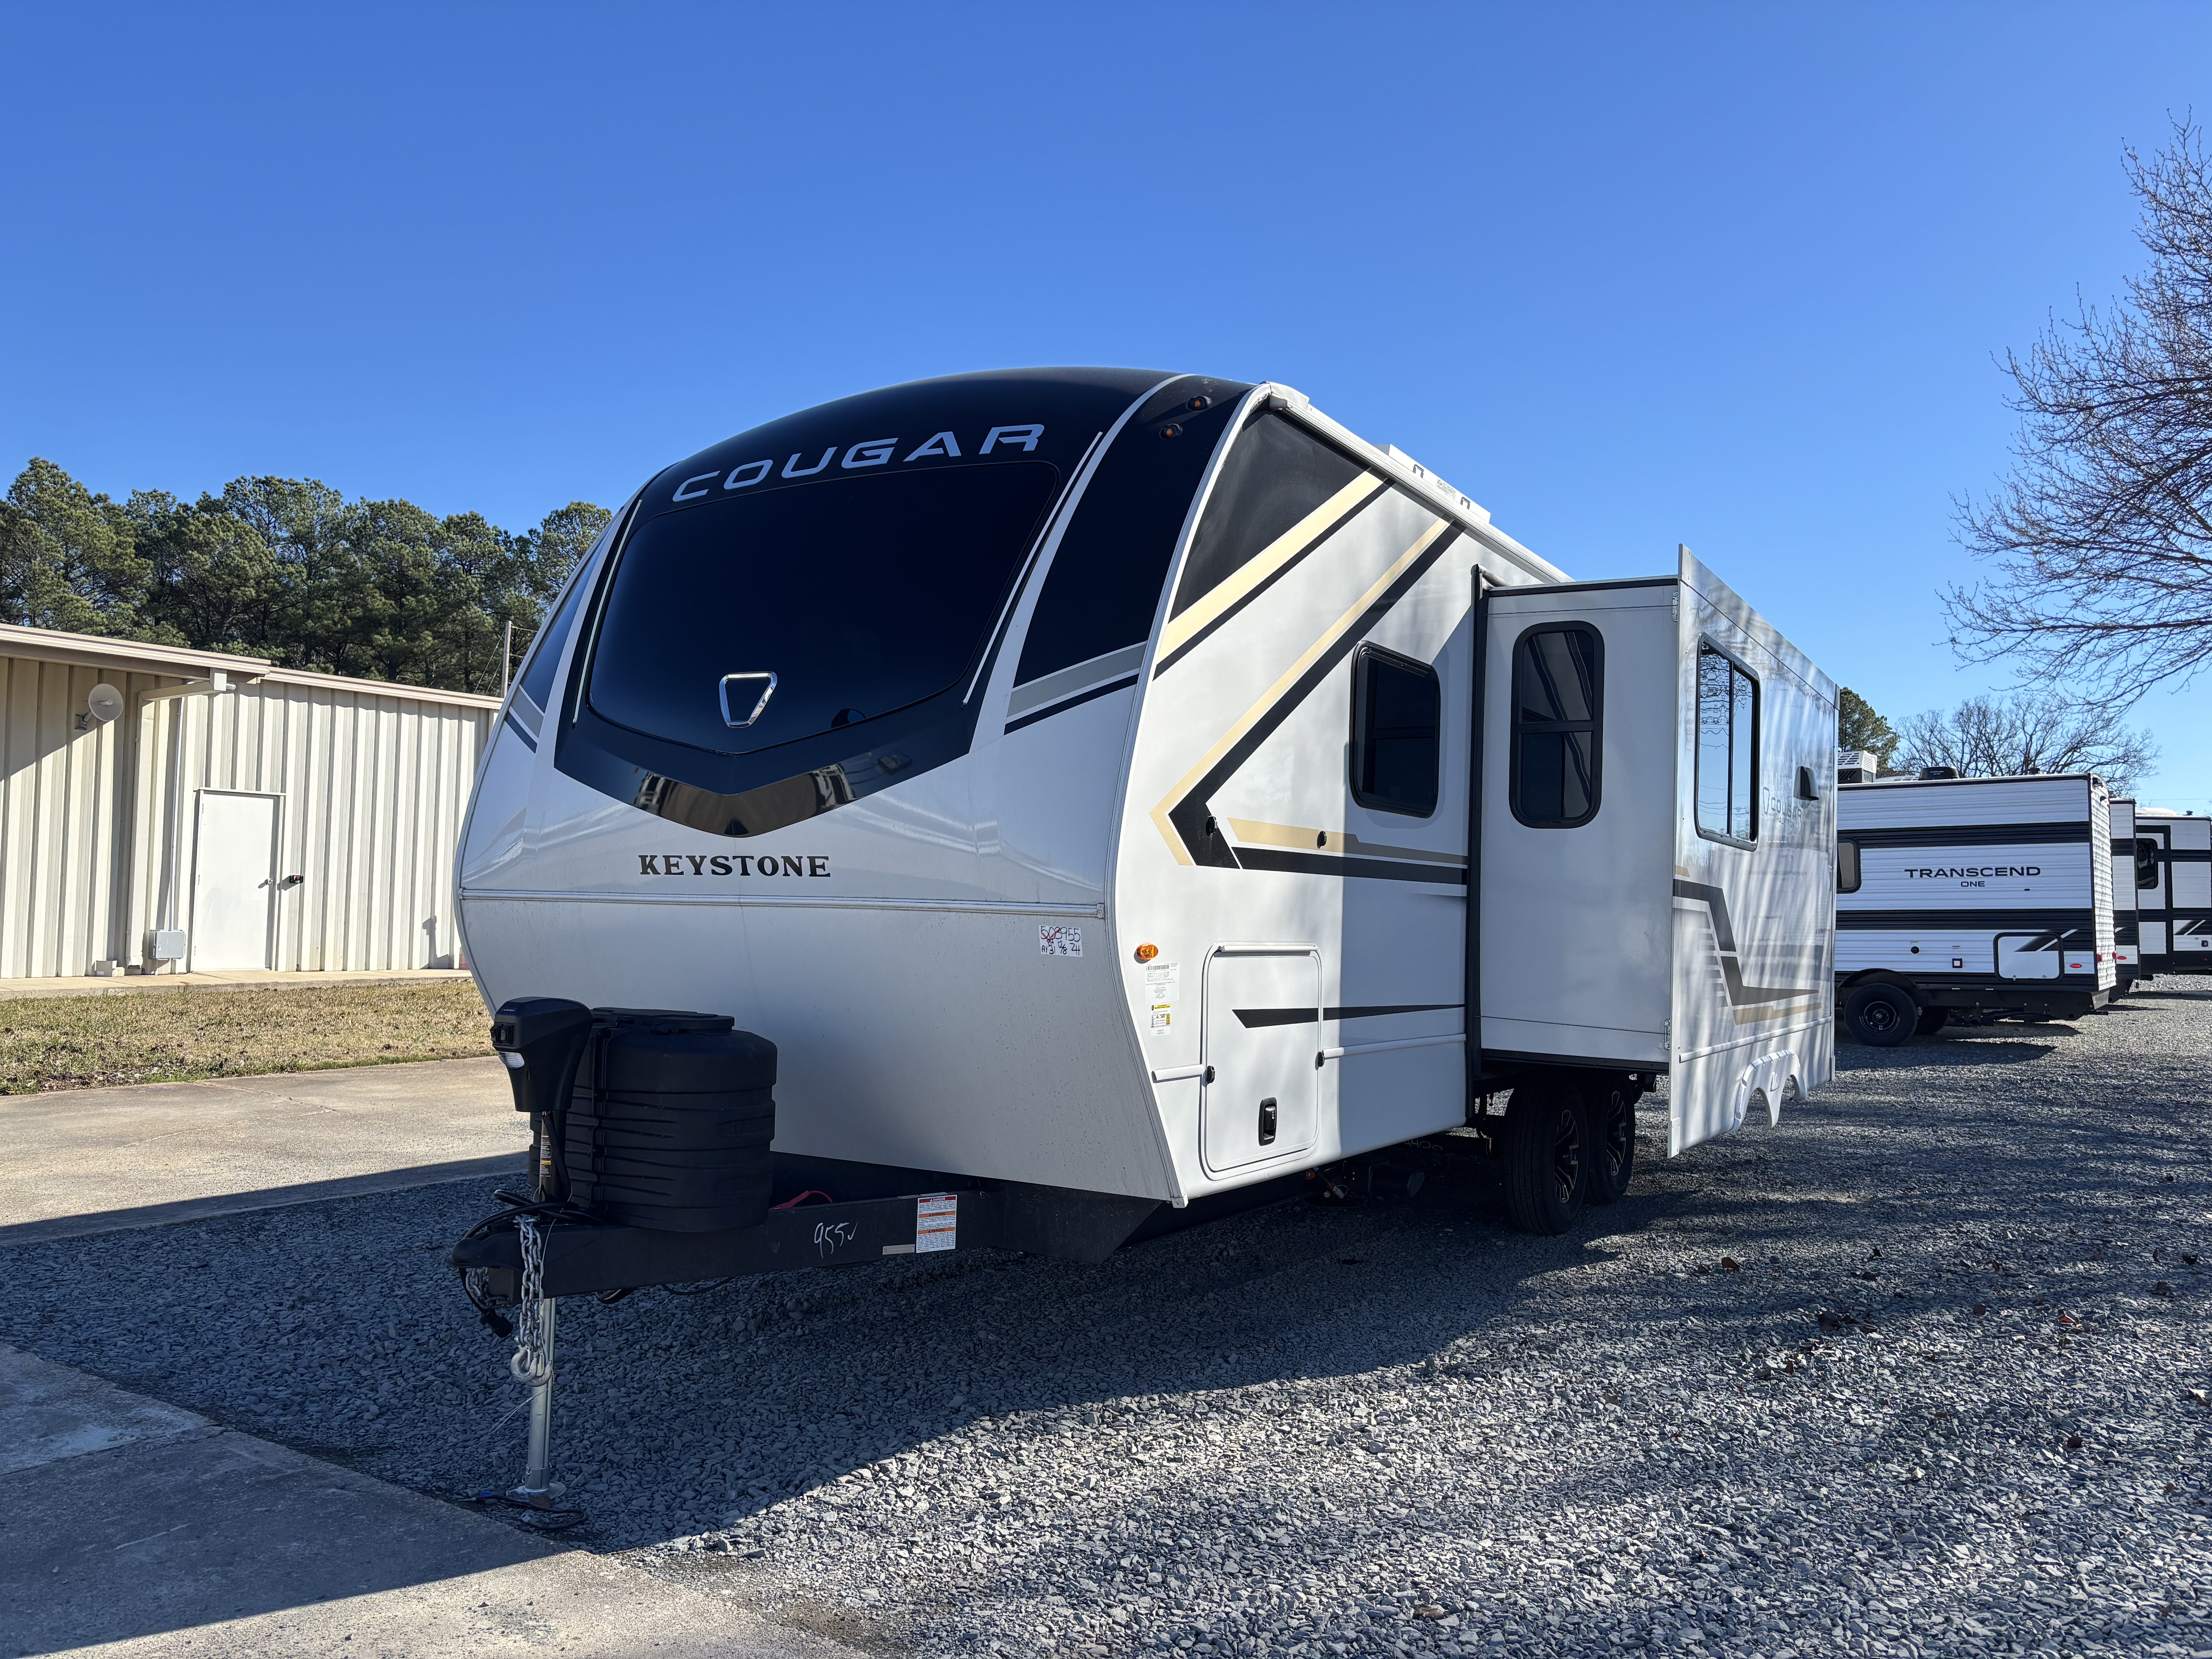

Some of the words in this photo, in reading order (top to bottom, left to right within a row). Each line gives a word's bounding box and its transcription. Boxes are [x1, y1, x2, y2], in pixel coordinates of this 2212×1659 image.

[672, 423, 1045, 503] COUGAR
[1771, 797, 1802, 823] COUGAR
[638, 855, 831, 877] KEYSTONE
[1904, 866, 2041, 879] TRANSCEND
